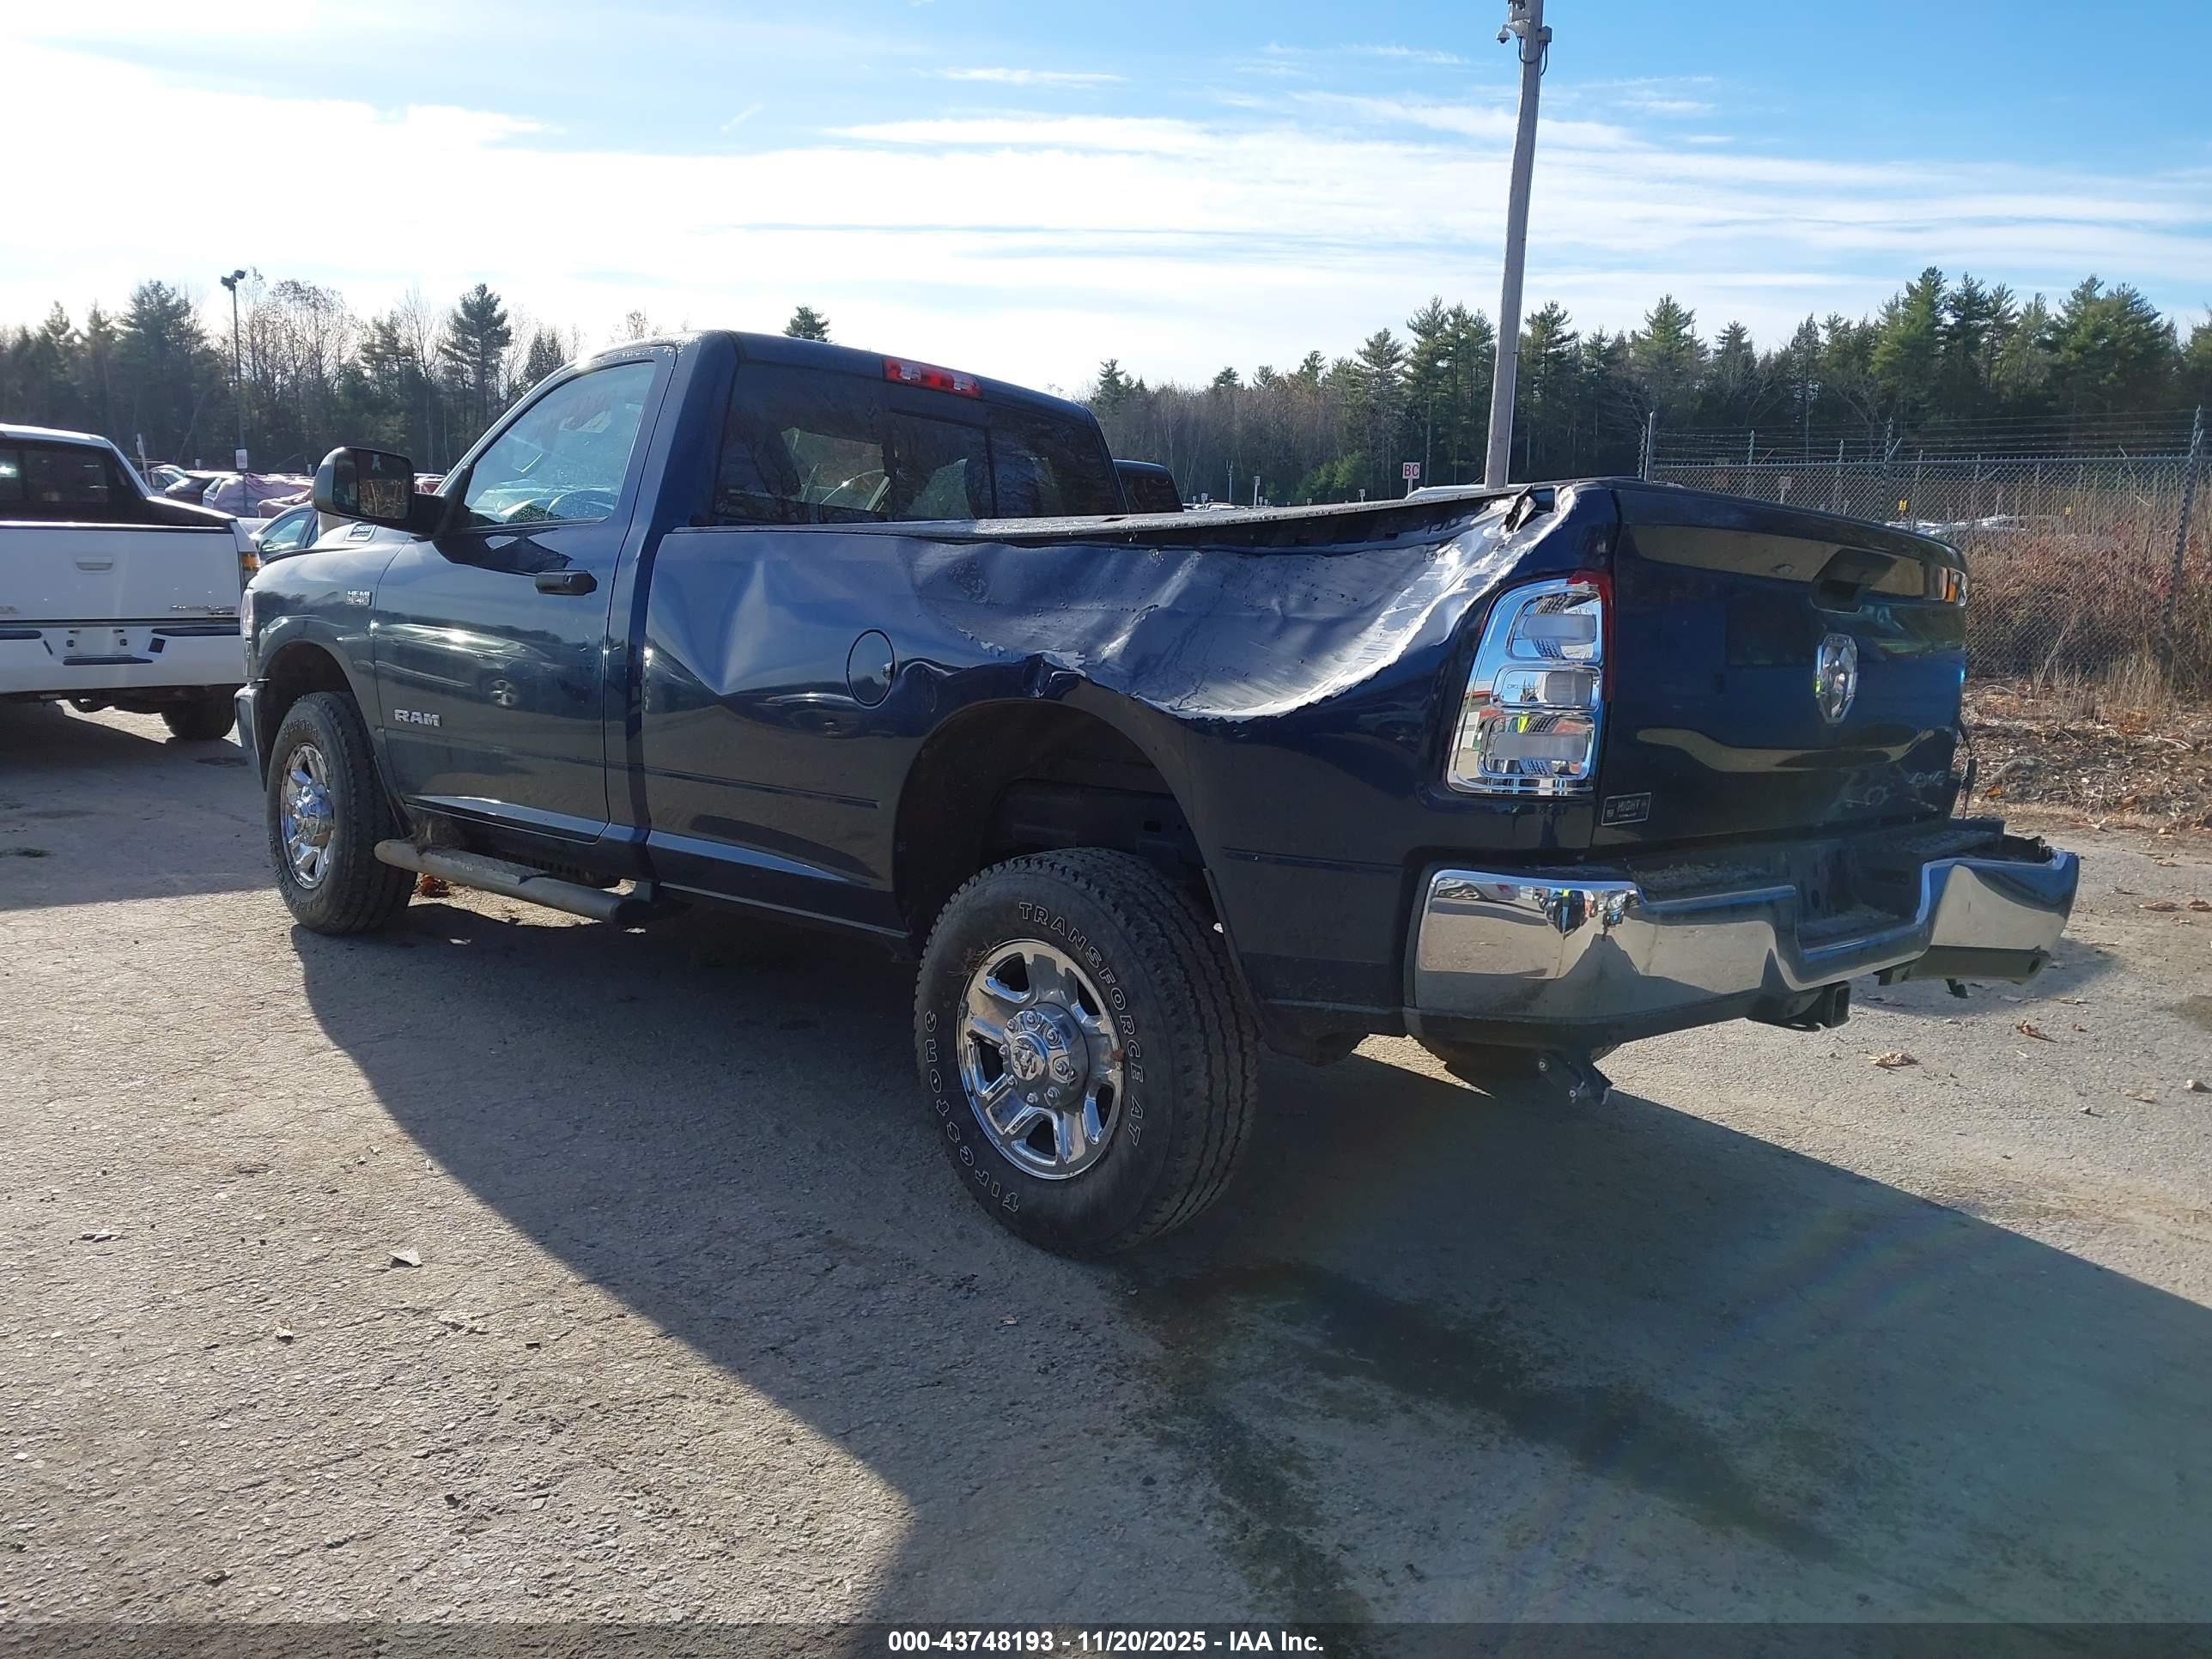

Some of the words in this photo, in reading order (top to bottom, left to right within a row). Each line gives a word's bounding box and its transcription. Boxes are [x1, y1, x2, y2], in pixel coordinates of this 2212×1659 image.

[1404, 464, 1419, 477] BC
[347, 590, 370, 599] HEMI
[394, 709, 441, 728] RAM
[1019, 902, 1144, 1084] TRANSFORCE
[1127, 1095, 1145, 1146] AT
